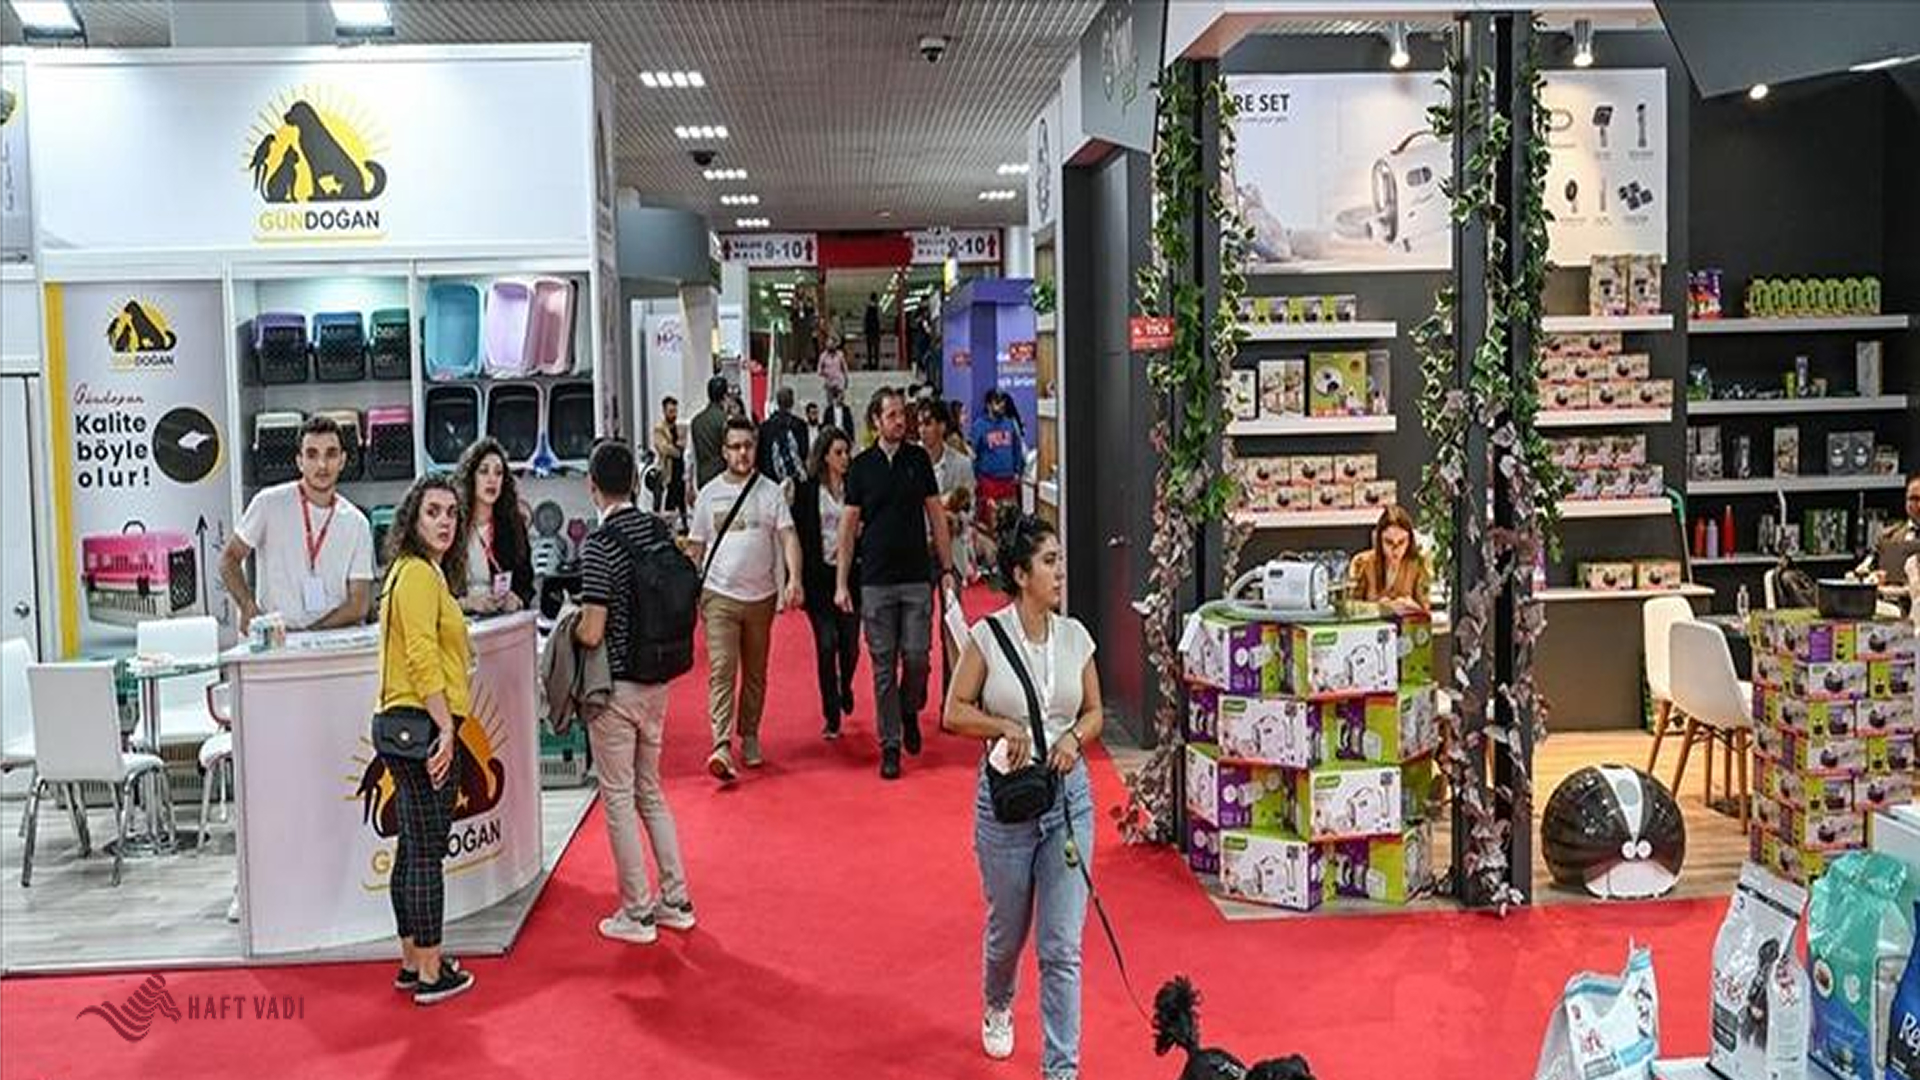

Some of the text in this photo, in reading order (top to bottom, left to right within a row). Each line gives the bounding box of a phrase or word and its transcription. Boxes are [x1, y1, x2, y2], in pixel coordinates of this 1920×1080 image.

[1259, 93, 1290, 112] SET
[259, 207, 380, 230] GÜNDOĞAN
[75, 412, 147, 435] Kalite
[77, 440, 148, 467] böyle
[78, 466, 150, 488] olur!
[372, 820, 501, 875] GOĞAN
